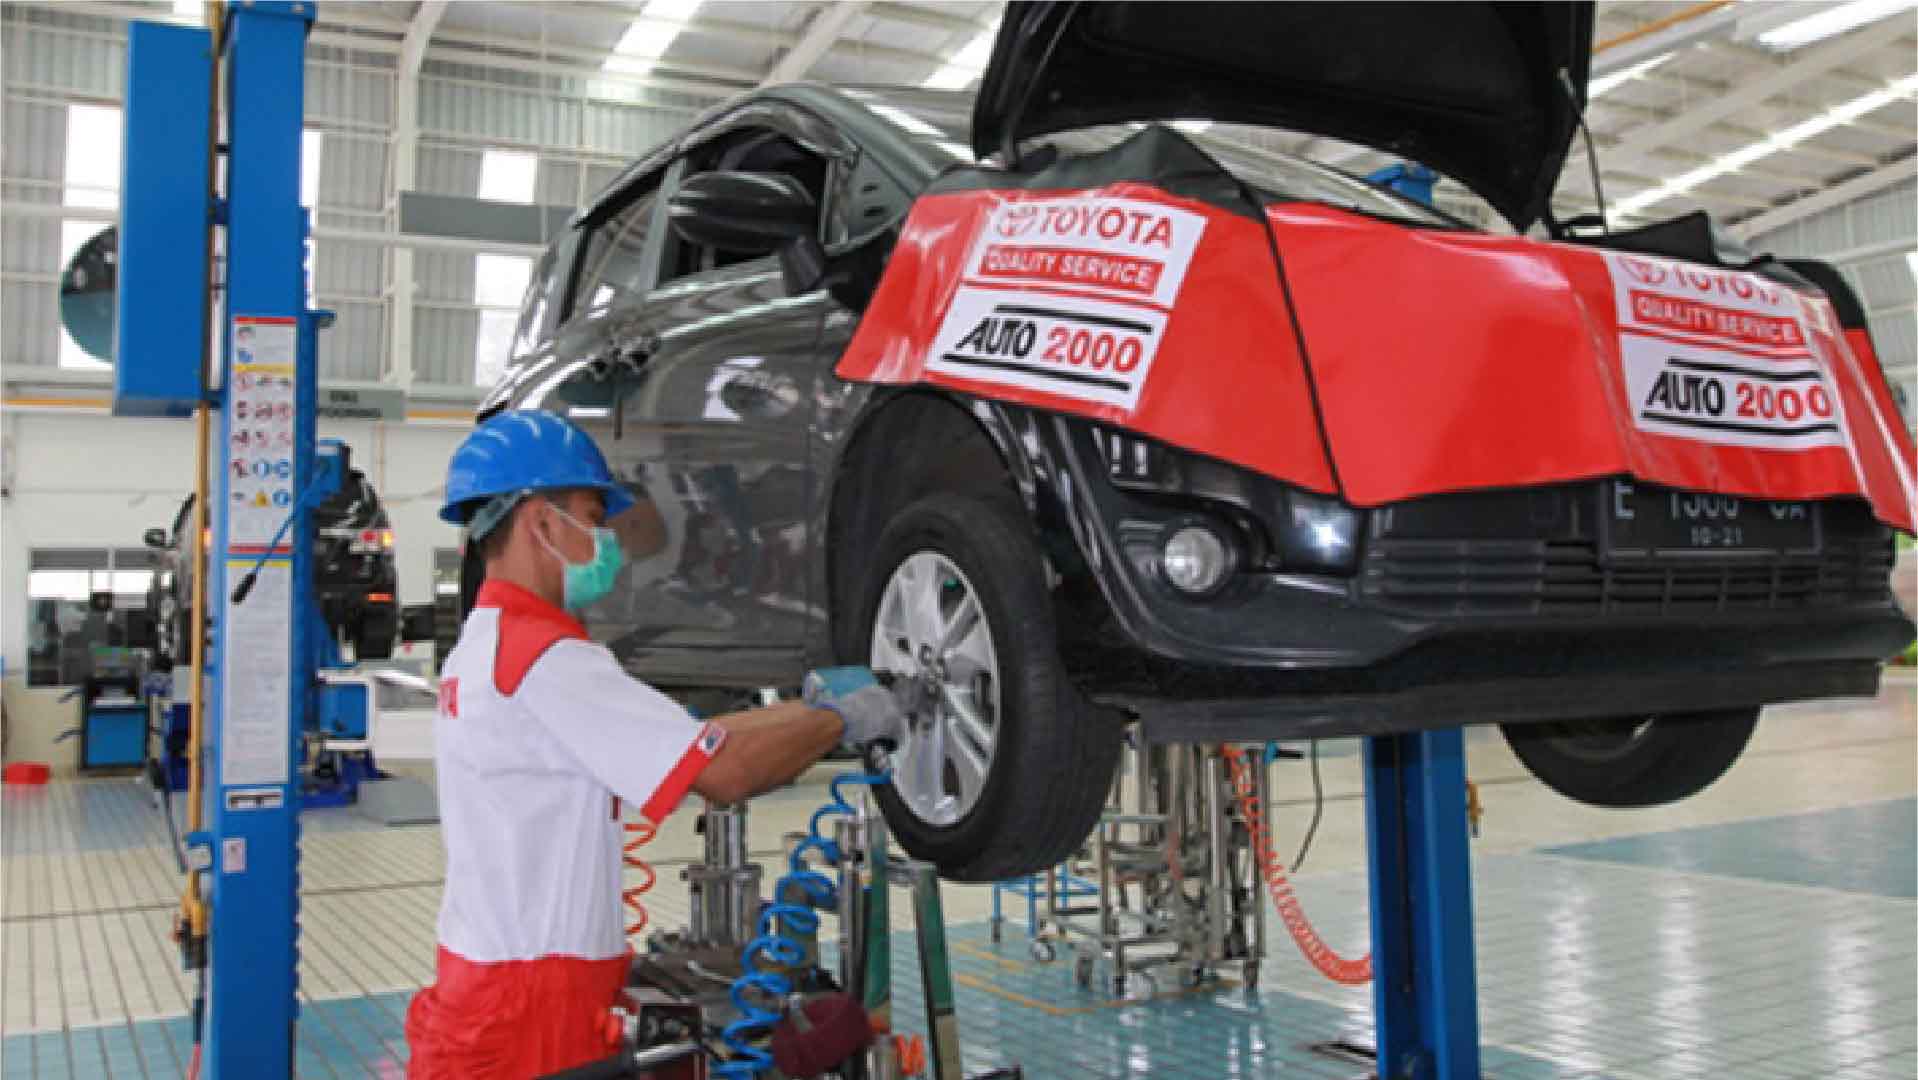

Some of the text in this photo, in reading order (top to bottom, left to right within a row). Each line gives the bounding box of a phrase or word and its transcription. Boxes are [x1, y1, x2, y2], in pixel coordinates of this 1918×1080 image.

[1040, 206, 1172, 248] TOYOTA
[986, 248, 1152, 285] QUALITY SERVICE
[1637, 297, 1798, 342] QUALITY SERVICE
[955, 318, 1143, 373] AUTO 2000
[1646, 371, 1832, 421] AUTO 2000
